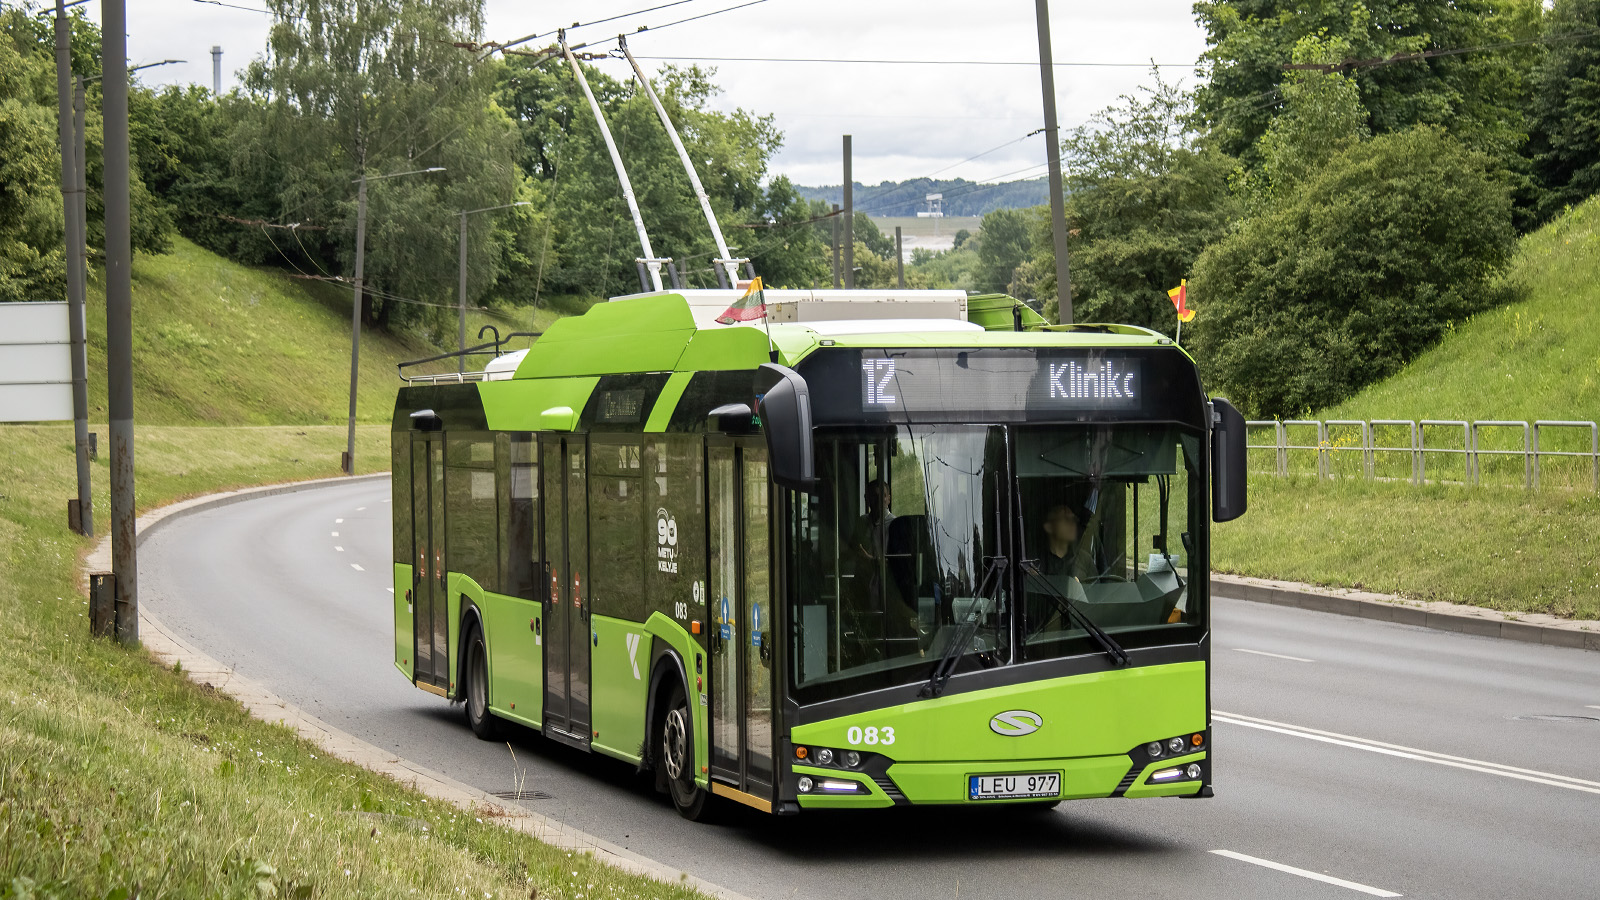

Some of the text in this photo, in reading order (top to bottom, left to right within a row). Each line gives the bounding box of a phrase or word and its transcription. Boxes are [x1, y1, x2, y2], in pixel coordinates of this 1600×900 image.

[862, 359, 896, 404] 12
[657, 518, 678, 546] 90
[675, 601, 688, 620] 083
[847, 726, 896, 746] 083
[981, 776, 1057, 794] LEU 977
